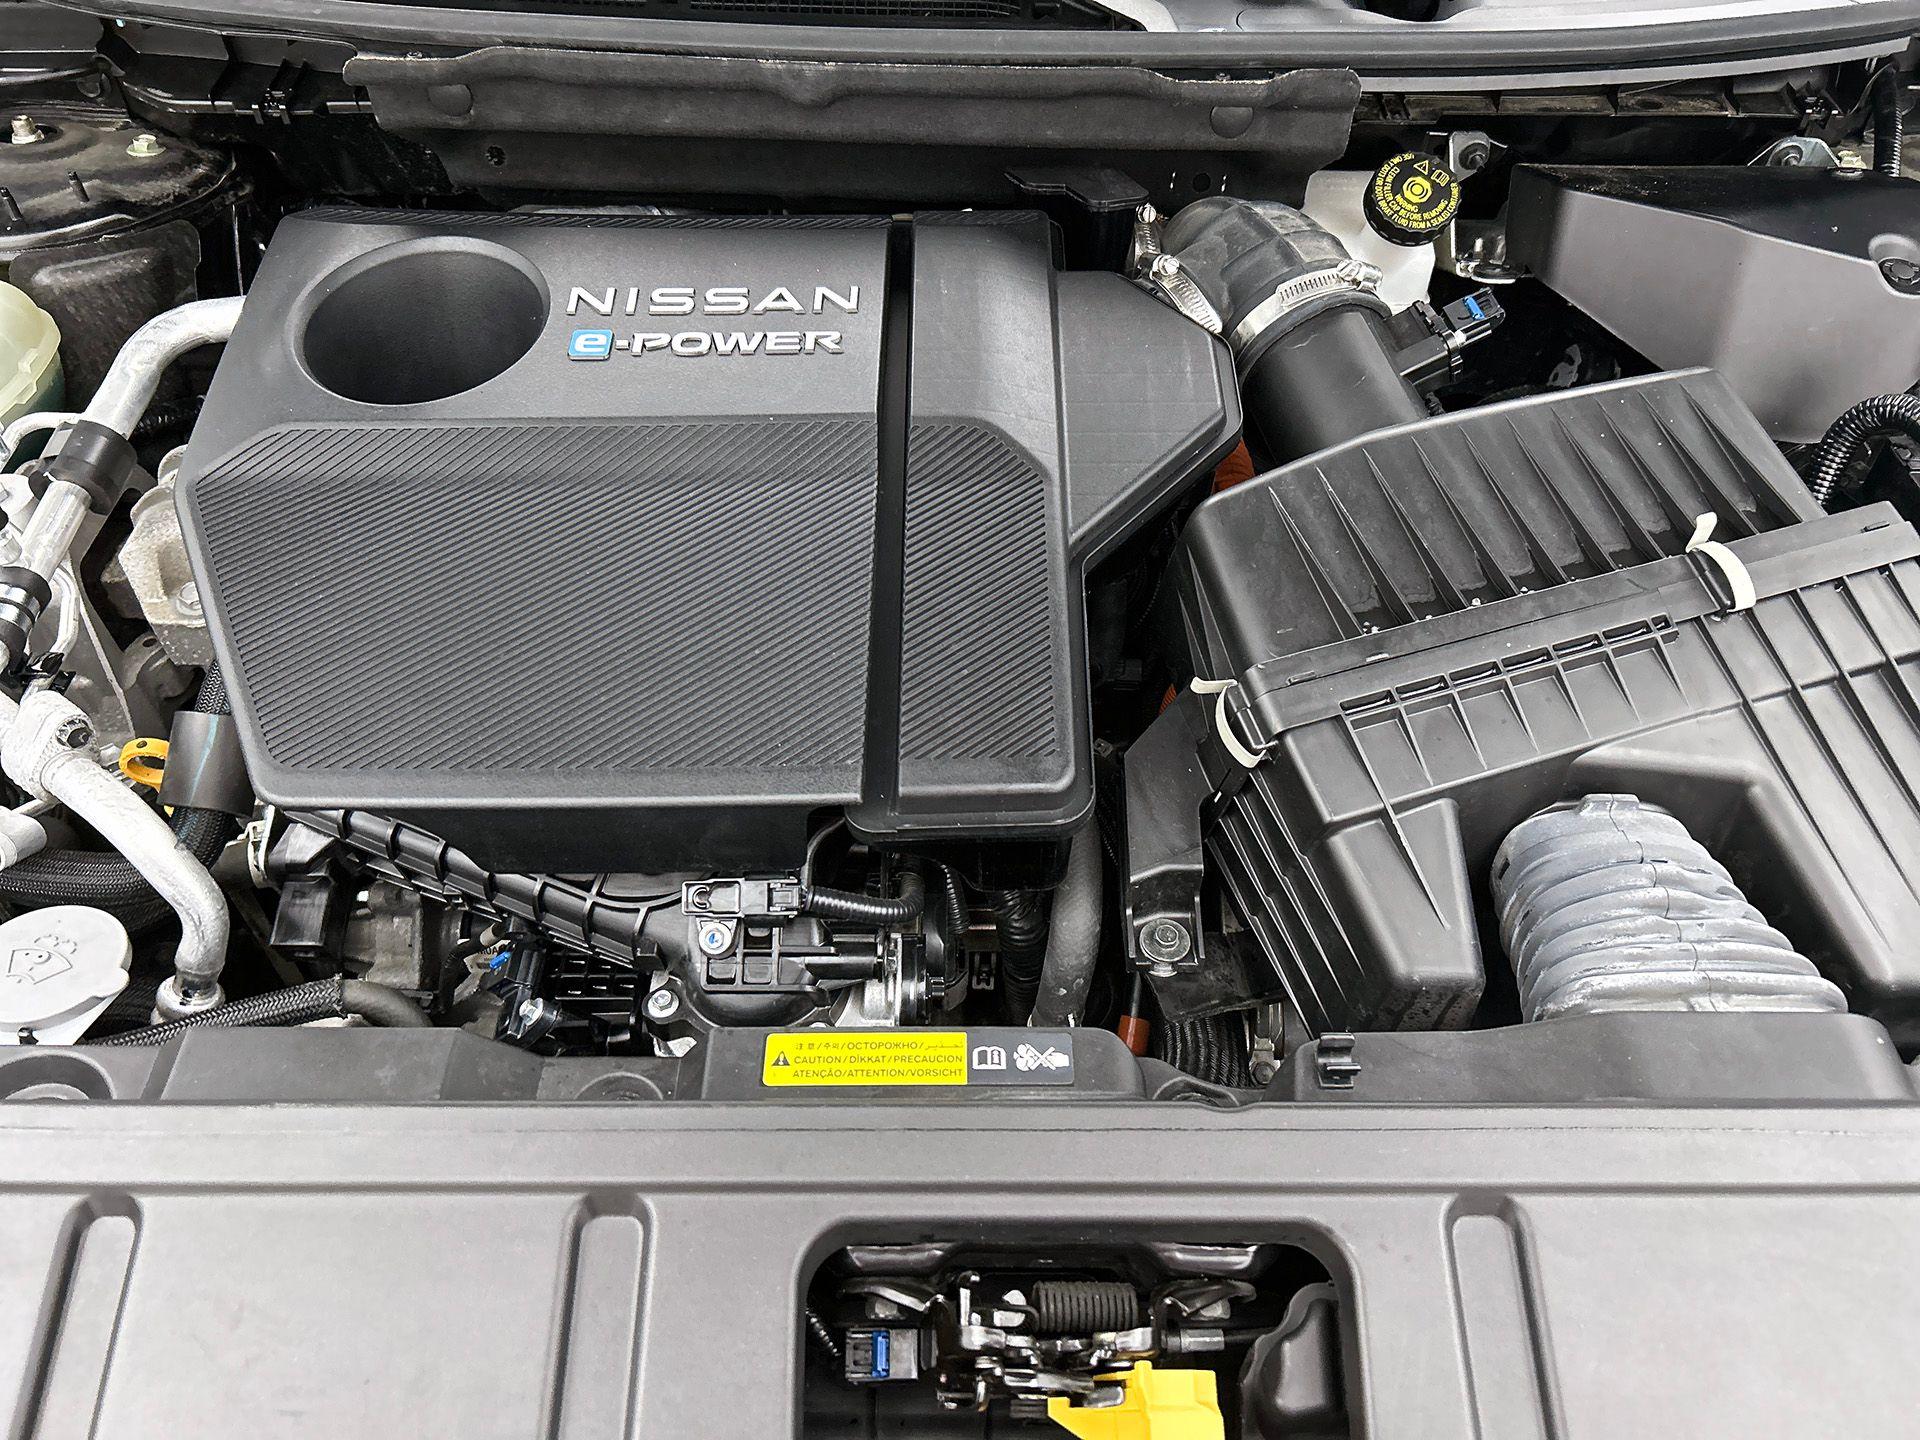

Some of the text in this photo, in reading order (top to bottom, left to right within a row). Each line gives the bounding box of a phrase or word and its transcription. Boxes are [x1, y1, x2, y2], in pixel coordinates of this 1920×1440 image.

[1383, 166, 1448, 220] CLEAN FILLER CAP BEFORE REMOVING
[1378, 200, 1393, 217] BRAKE
[1391, 213, 1409, 227] FLUID
[1408, 220, 1426, 229] FROM
[1426, 219, 1432, 228] A
[1431, 211, 1451, 227] SEALED
[566, 286, 859, 315] NISSAN
[568, 329, 844, 360] e-POWER
